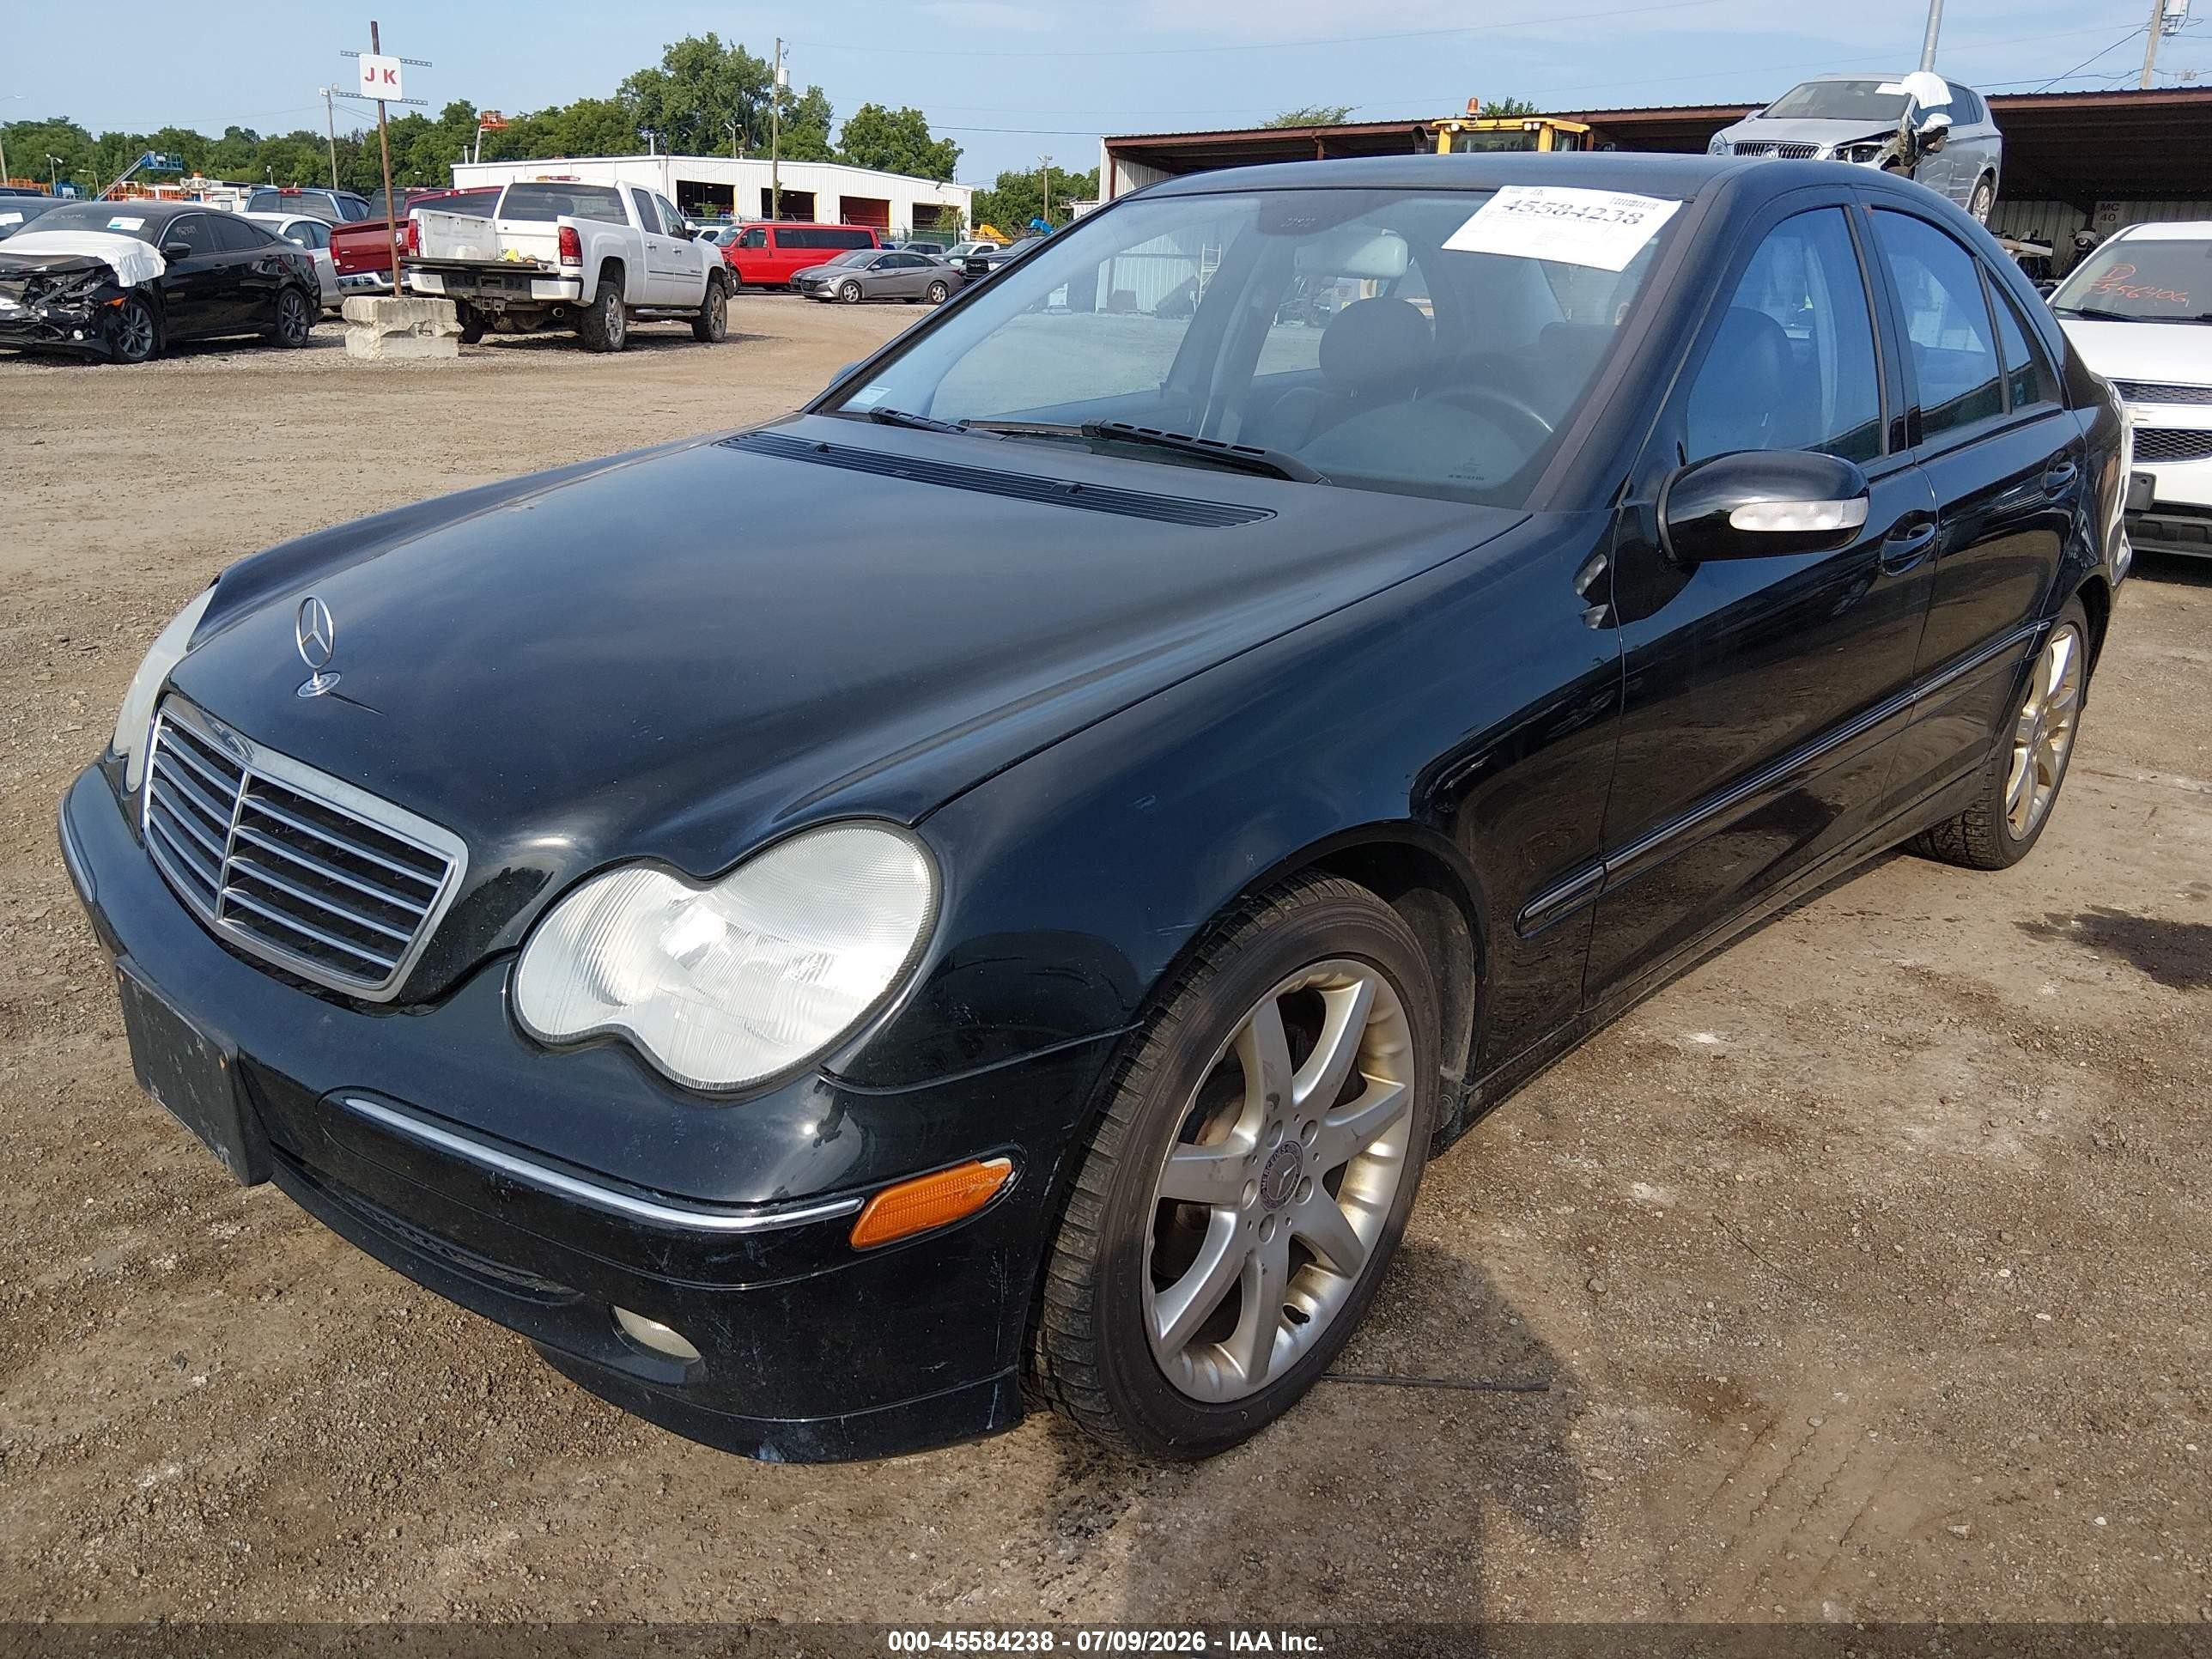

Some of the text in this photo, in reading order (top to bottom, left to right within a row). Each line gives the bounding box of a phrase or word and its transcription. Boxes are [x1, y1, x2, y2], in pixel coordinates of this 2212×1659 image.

[364, 67, 397, 85] J K
[1503, 199, 1644, 225] 45584238
[2100, 203, 2120, 211] MC
[2100, 213, 2117, 222] 40
